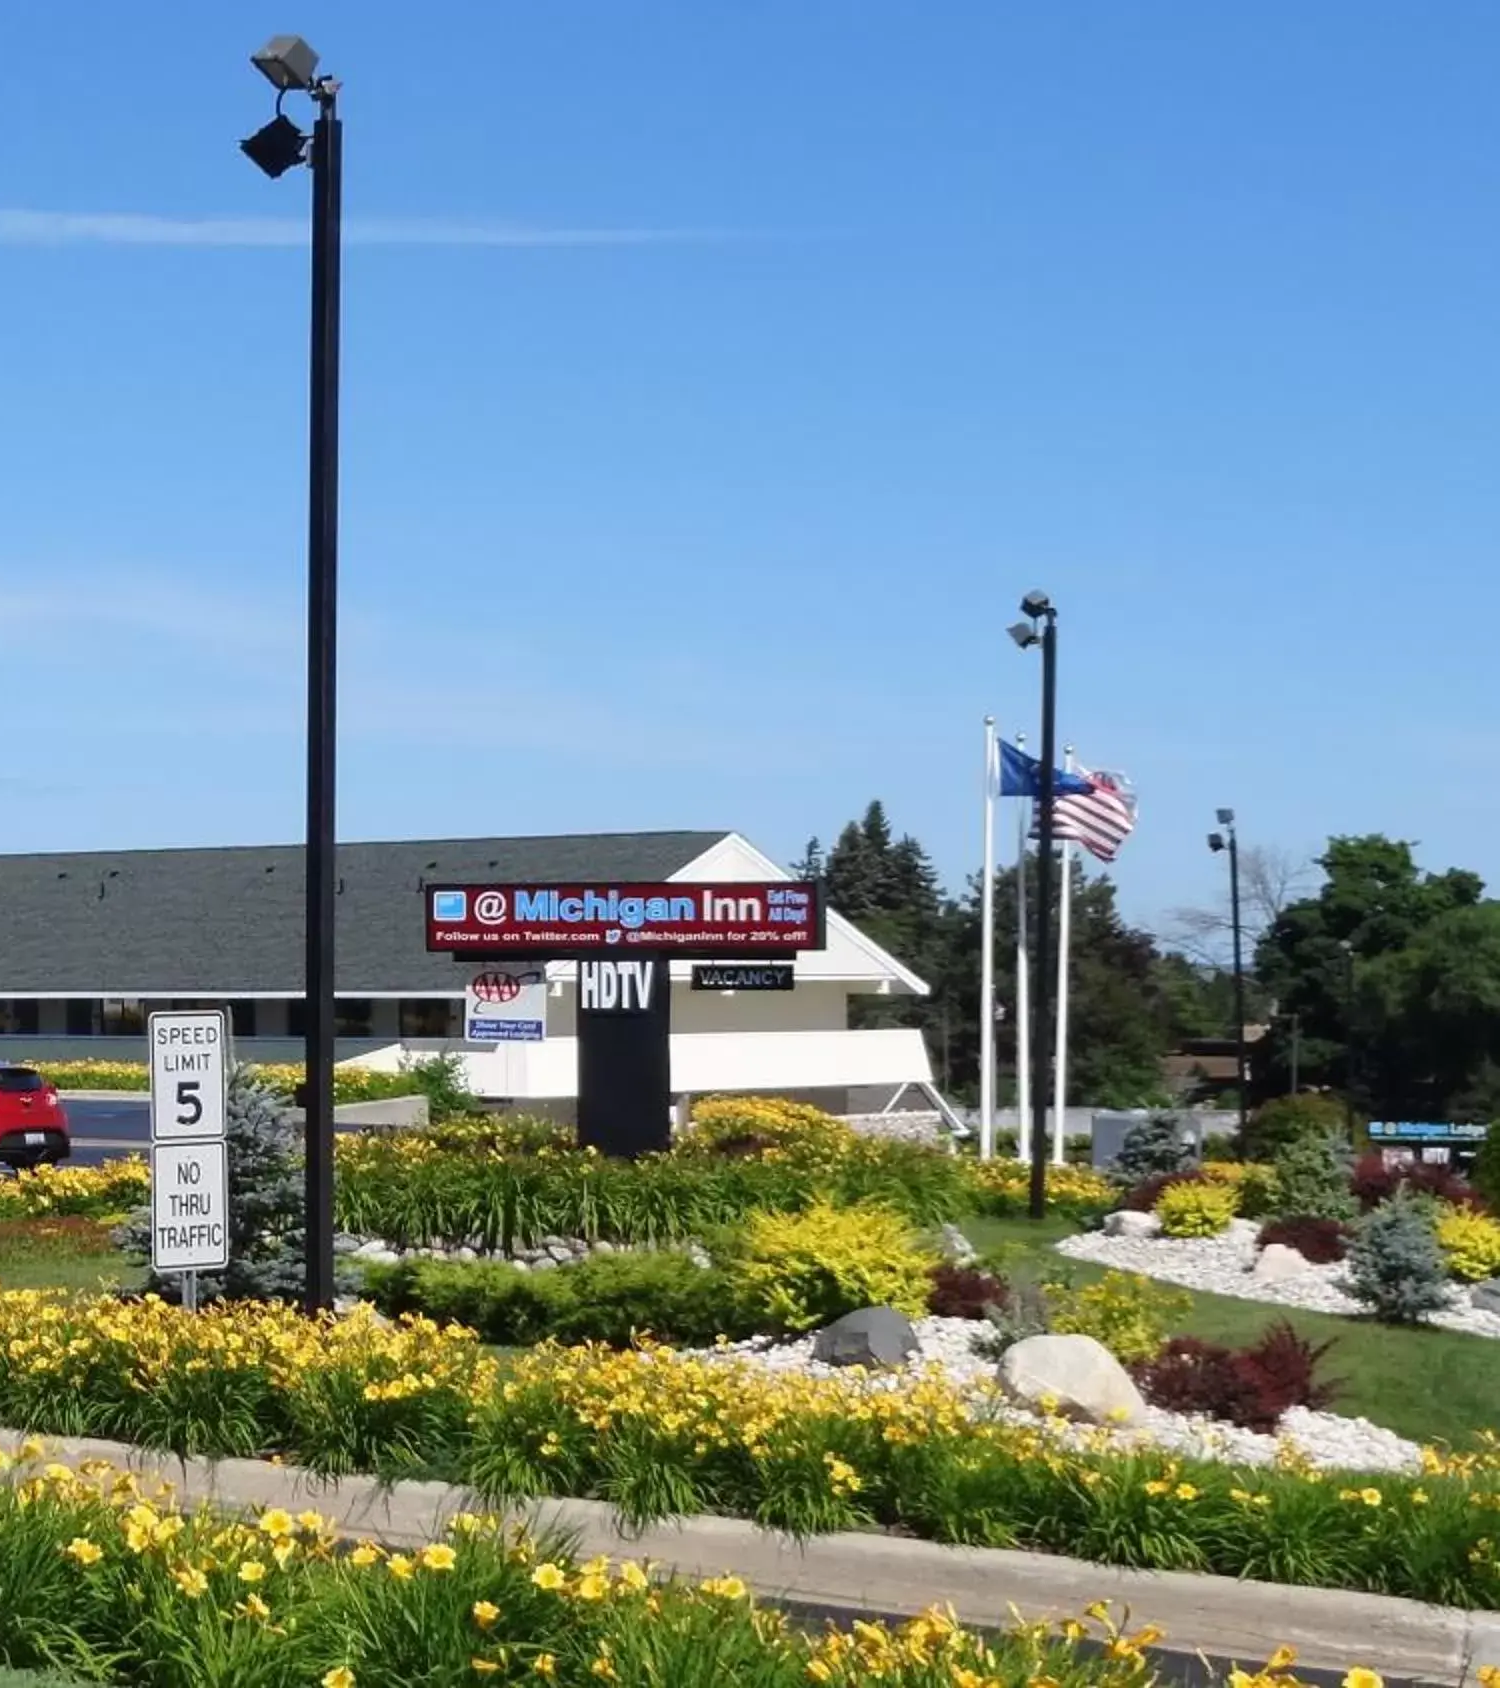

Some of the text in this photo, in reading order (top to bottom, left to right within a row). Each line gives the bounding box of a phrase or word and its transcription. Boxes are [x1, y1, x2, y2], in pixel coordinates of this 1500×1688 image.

[474, 889, 761, 929] @ Michigan Inn
[435, 931, 480, 941] Follow
[484, 932, 500, 941] us
[502, 932, 520, 941] on
[524, 931, 600, 941] Twitter.com
[727, 931, 746, 941] for
[581, 961, 653, 1009] HDTV
[700, 970, 786, 986] VACANCY
[157, 1027, 218, 1045] SPEED
[164, 1053, 211, 1072] LIMIT
[176, 1081, 203, 1126] 5
[177, 1161, 200, 1185] NO
[169, 1193, 211, 1217] THRU
[159, 1223, 222, 1250] TRAFFIC
